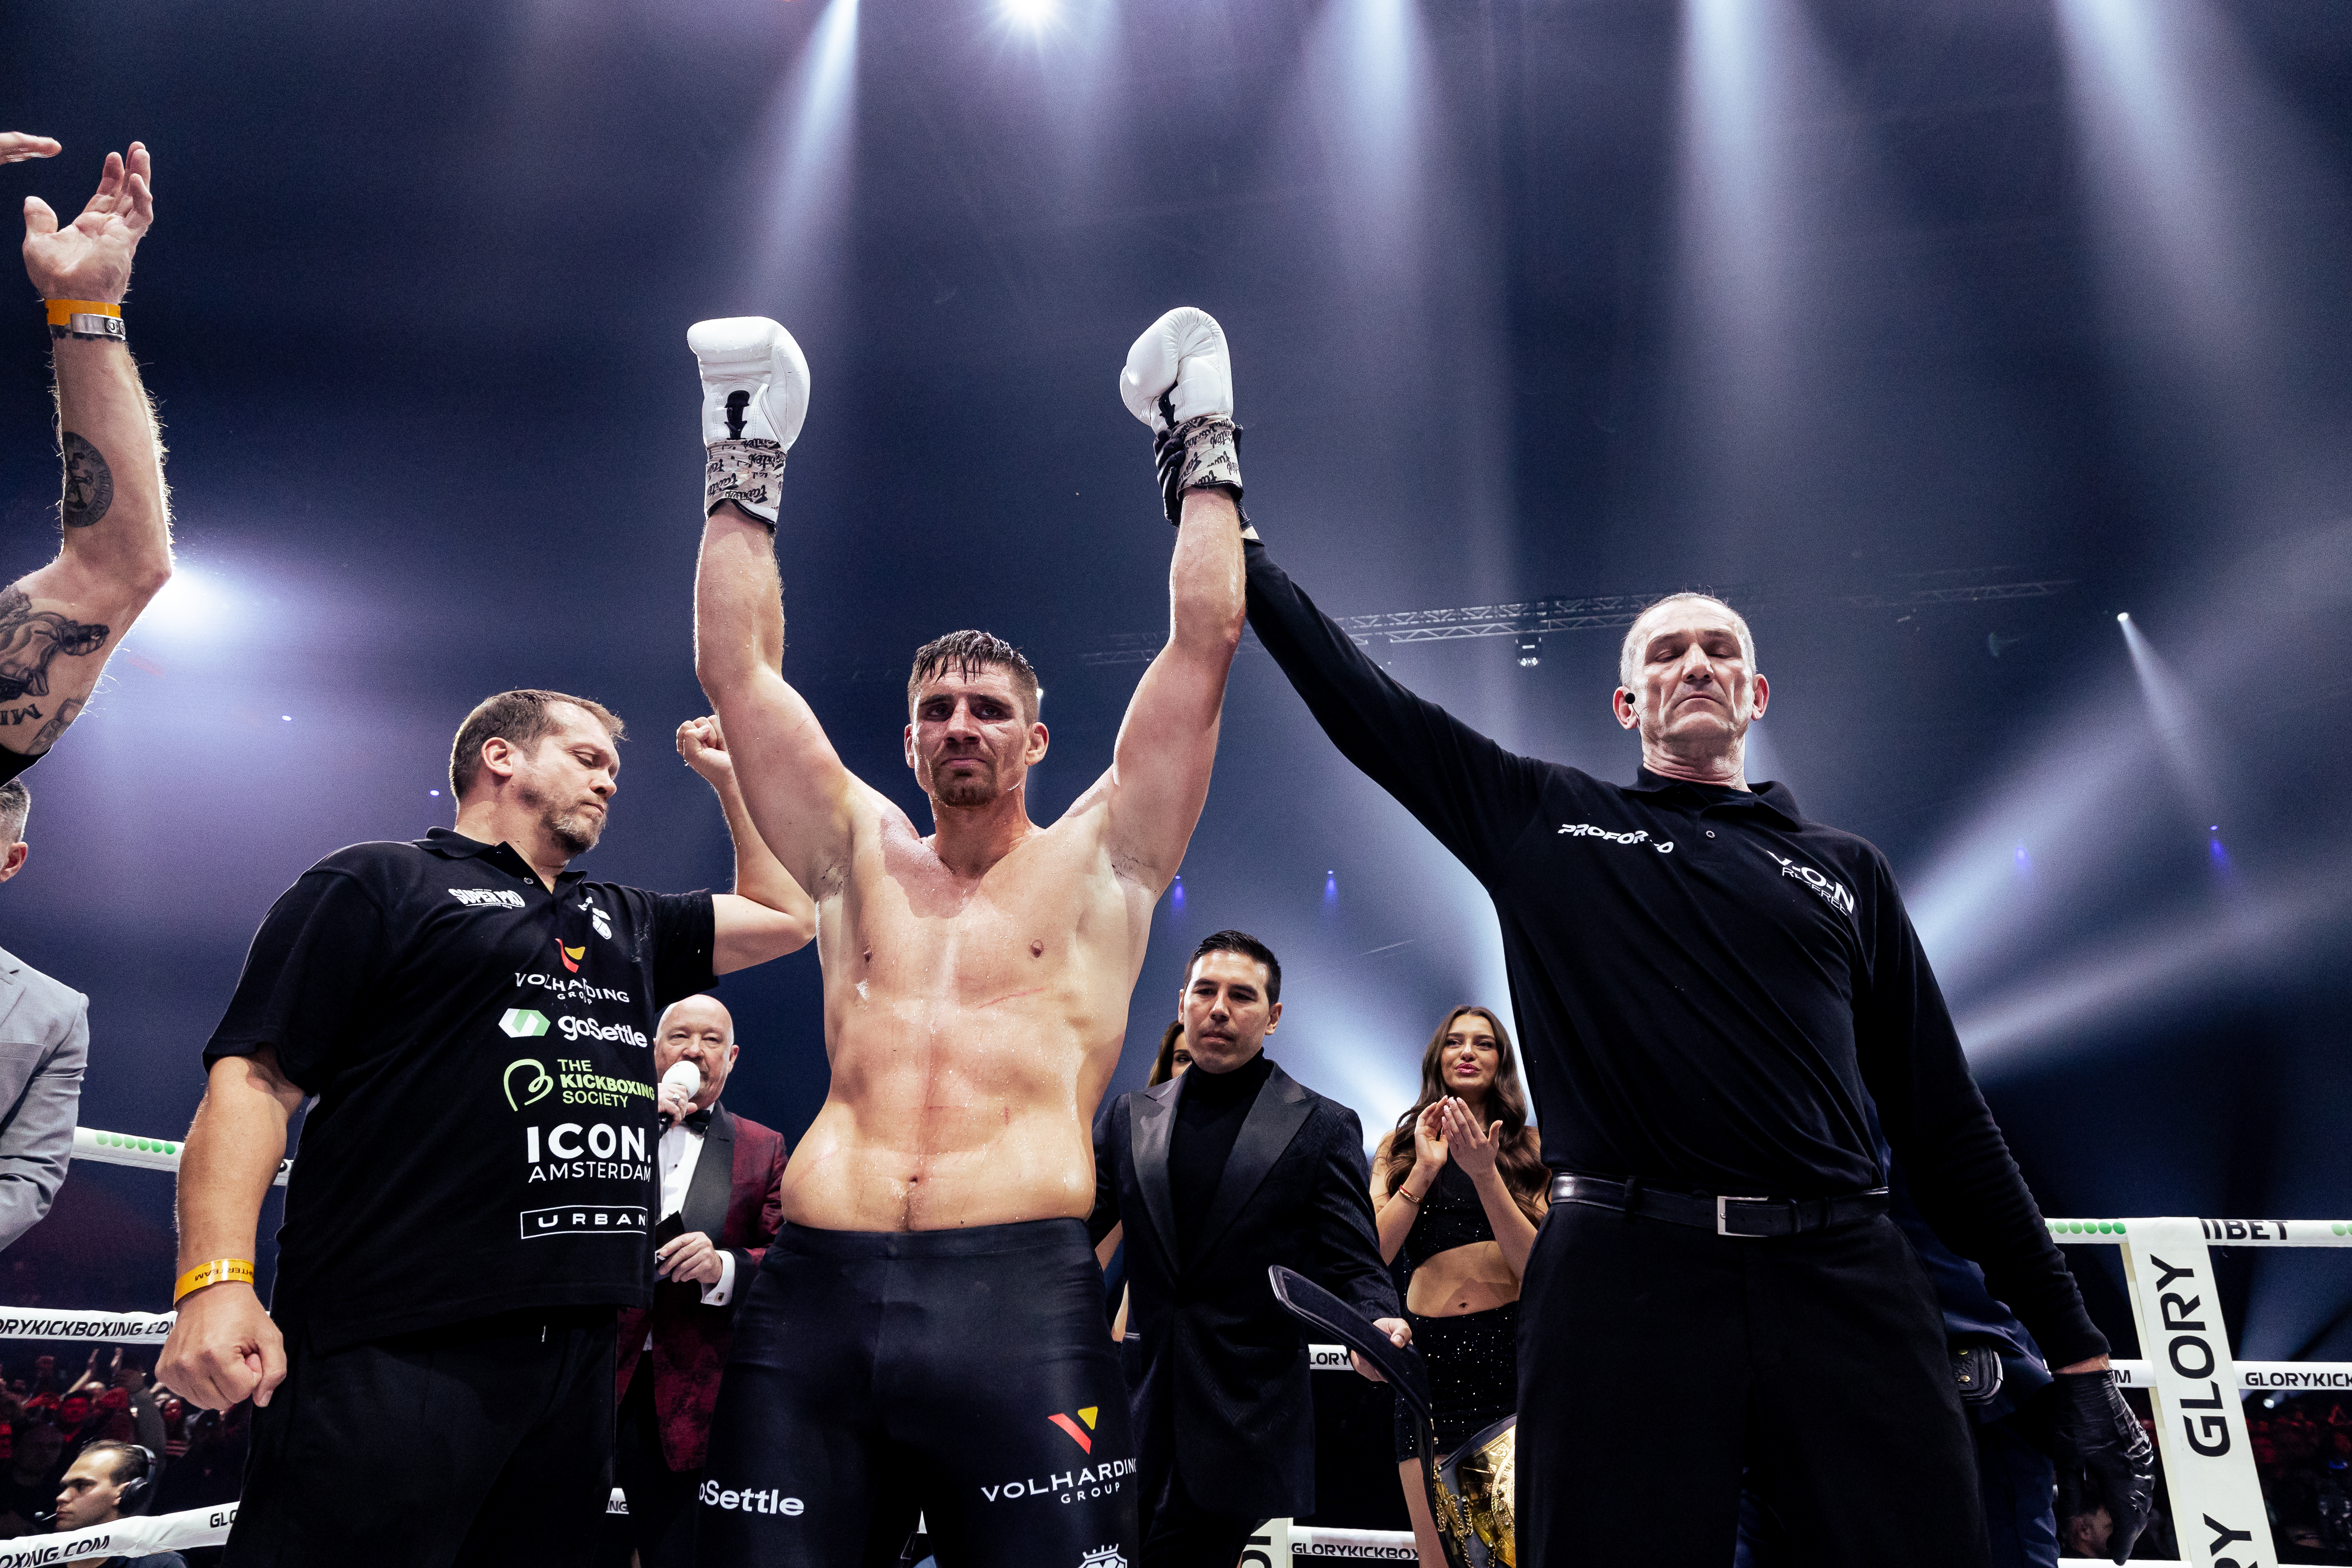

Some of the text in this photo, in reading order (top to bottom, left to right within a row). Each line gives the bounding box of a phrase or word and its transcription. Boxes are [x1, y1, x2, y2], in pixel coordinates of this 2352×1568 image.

[448, 888, 526, 907] SUPER PRO
[558, 1016, 647, 1048] goSettle
[557, 1059, 592, 1072] THE
[560, 1074, 655, 1101] KICKBOXING
[562, 1090, 628, 1108] SOCIETY
[528, 1161, 651, 1183] AMSTERDAM
[538, 1213, 646, 1228] URBAN
[2150, 1254, 2231, 1457] GLORY
[1061, 1482, 1120, 1504] GROUP
